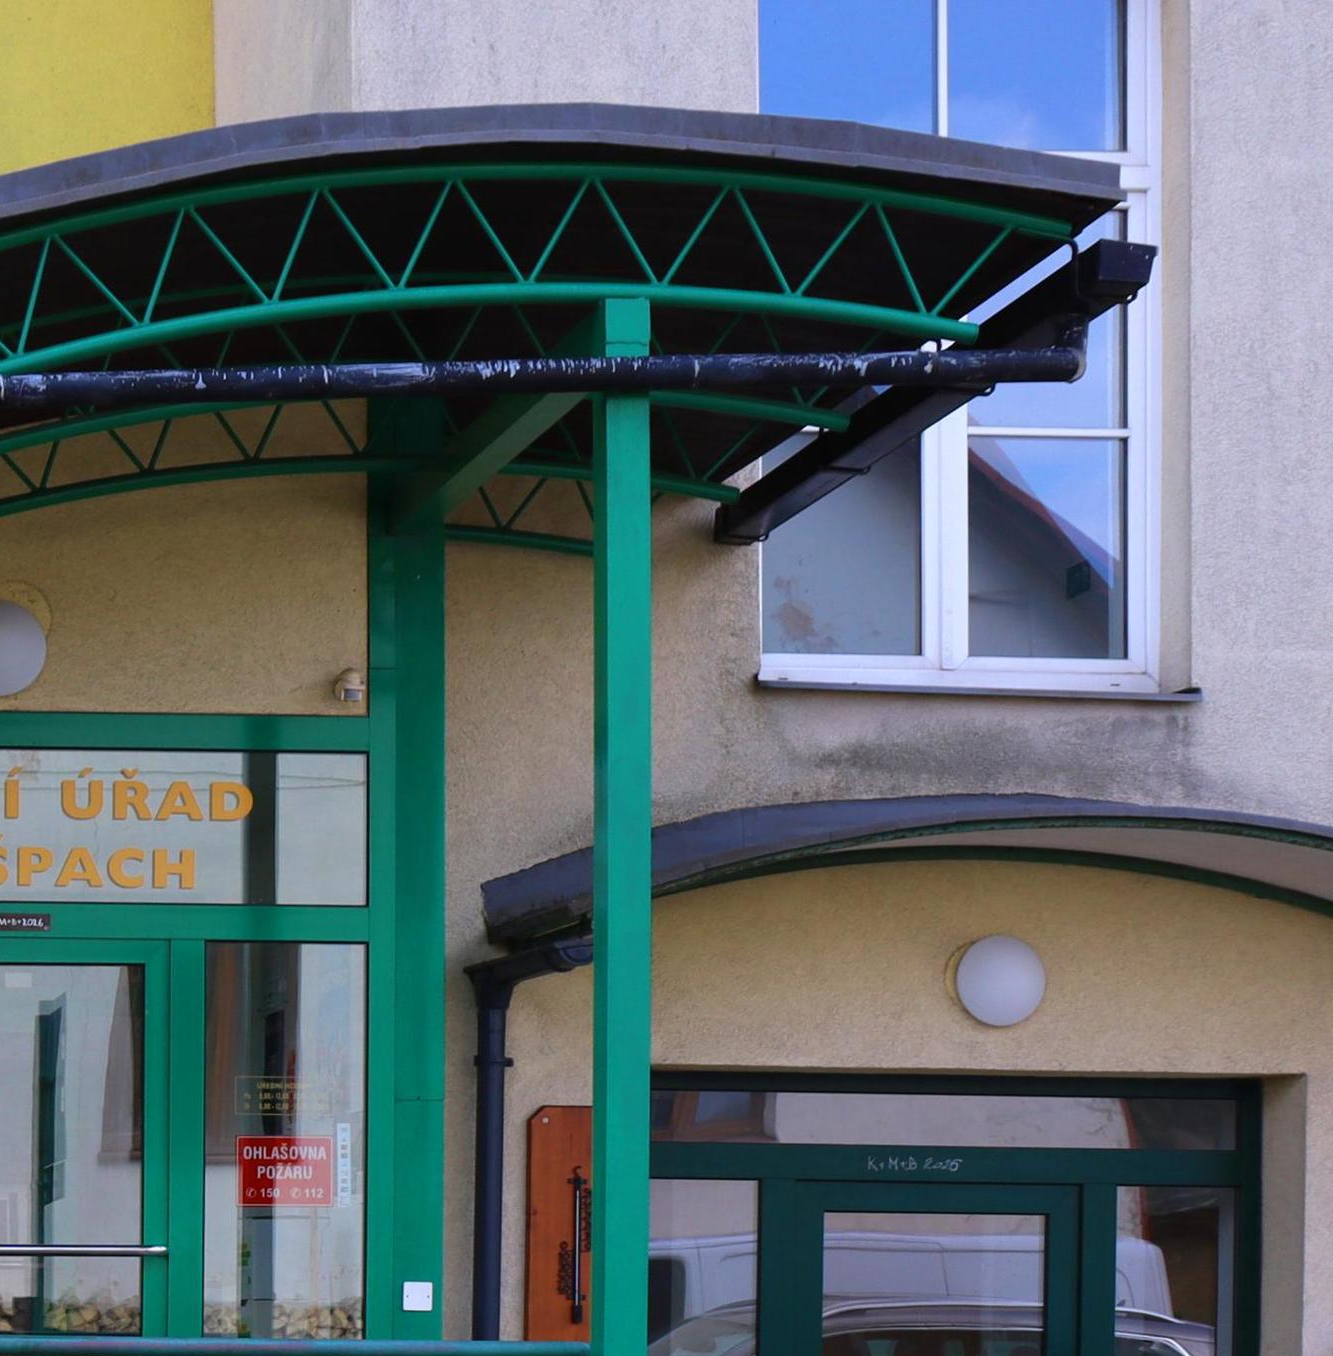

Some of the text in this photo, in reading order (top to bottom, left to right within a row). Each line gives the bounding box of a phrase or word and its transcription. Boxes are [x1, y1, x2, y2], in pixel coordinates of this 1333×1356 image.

[60, 767, 254, 822] ÚŘAD
[243, 1143, 327, 1160] OHLAŠOVNA
[257, 1162, 313, 1179] POŽÁRU
[260, 1188, 324, 1198] 150 112
